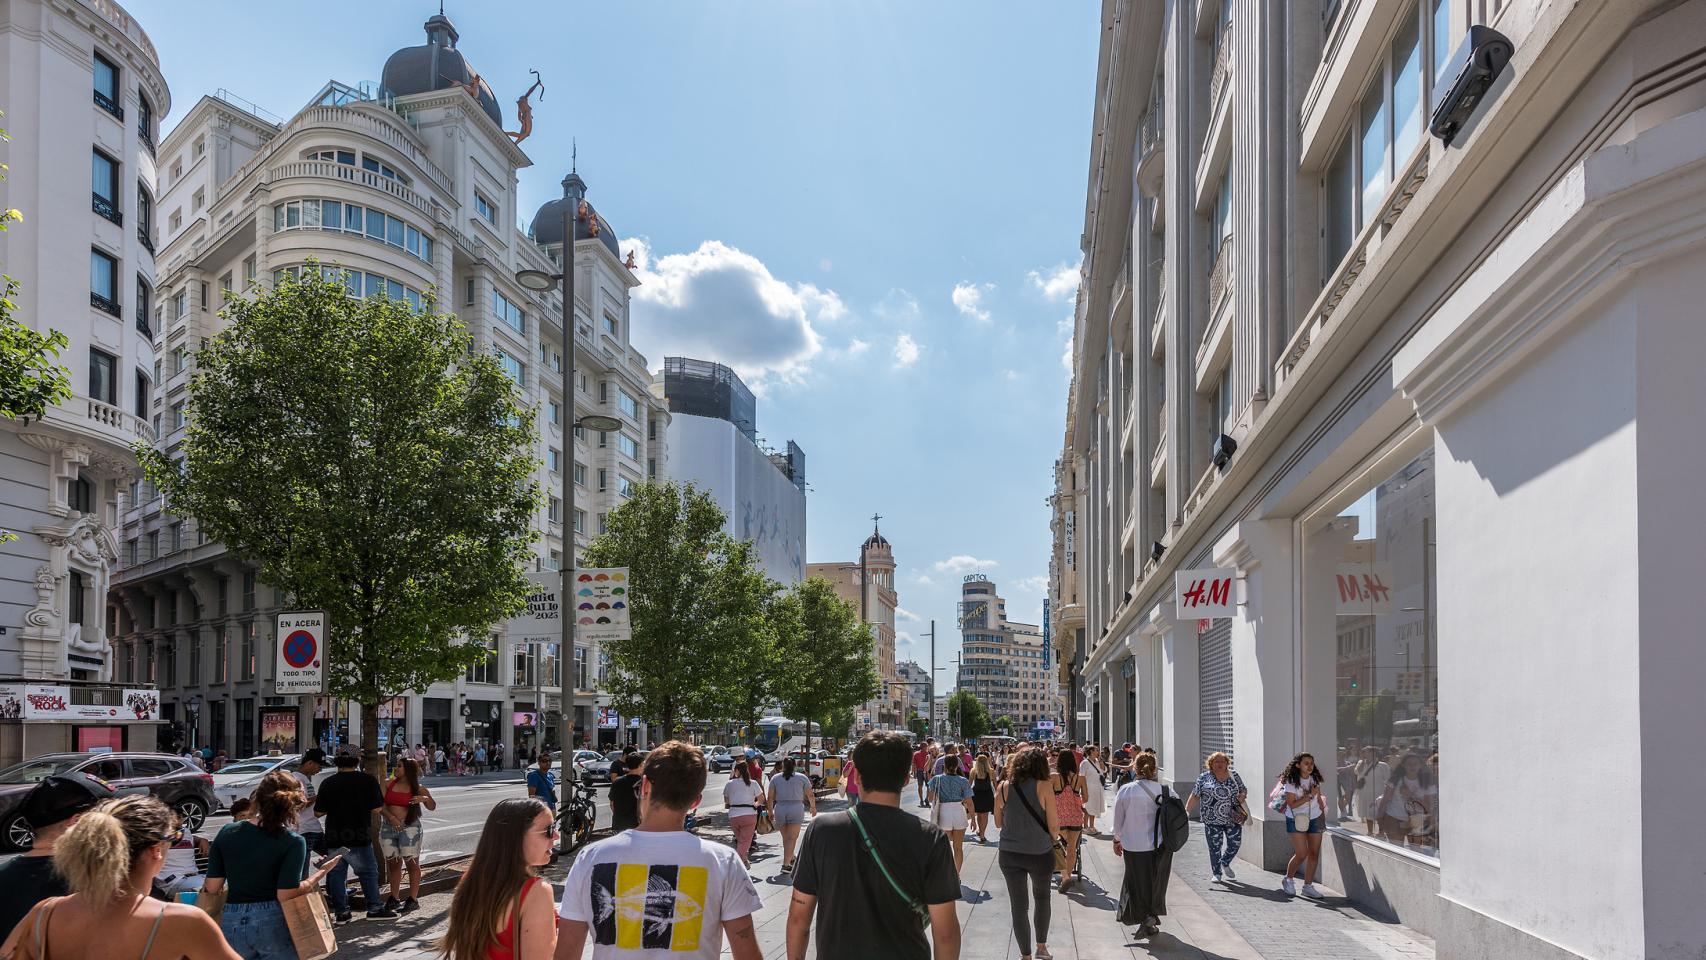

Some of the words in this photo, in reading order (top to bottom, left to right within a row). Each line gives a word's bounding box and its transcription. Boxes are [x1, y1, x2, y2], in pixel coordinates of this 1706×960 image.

[963, 573, 987, 582] CAPITOL
[1183, 577, 1232, 608] H&M
[524, 593, 555, 602] adrid
[280, 620, 291, 628] EN
[295, 619, 321, 627] ACERA
[34, 700, 67, 711] ROCK
